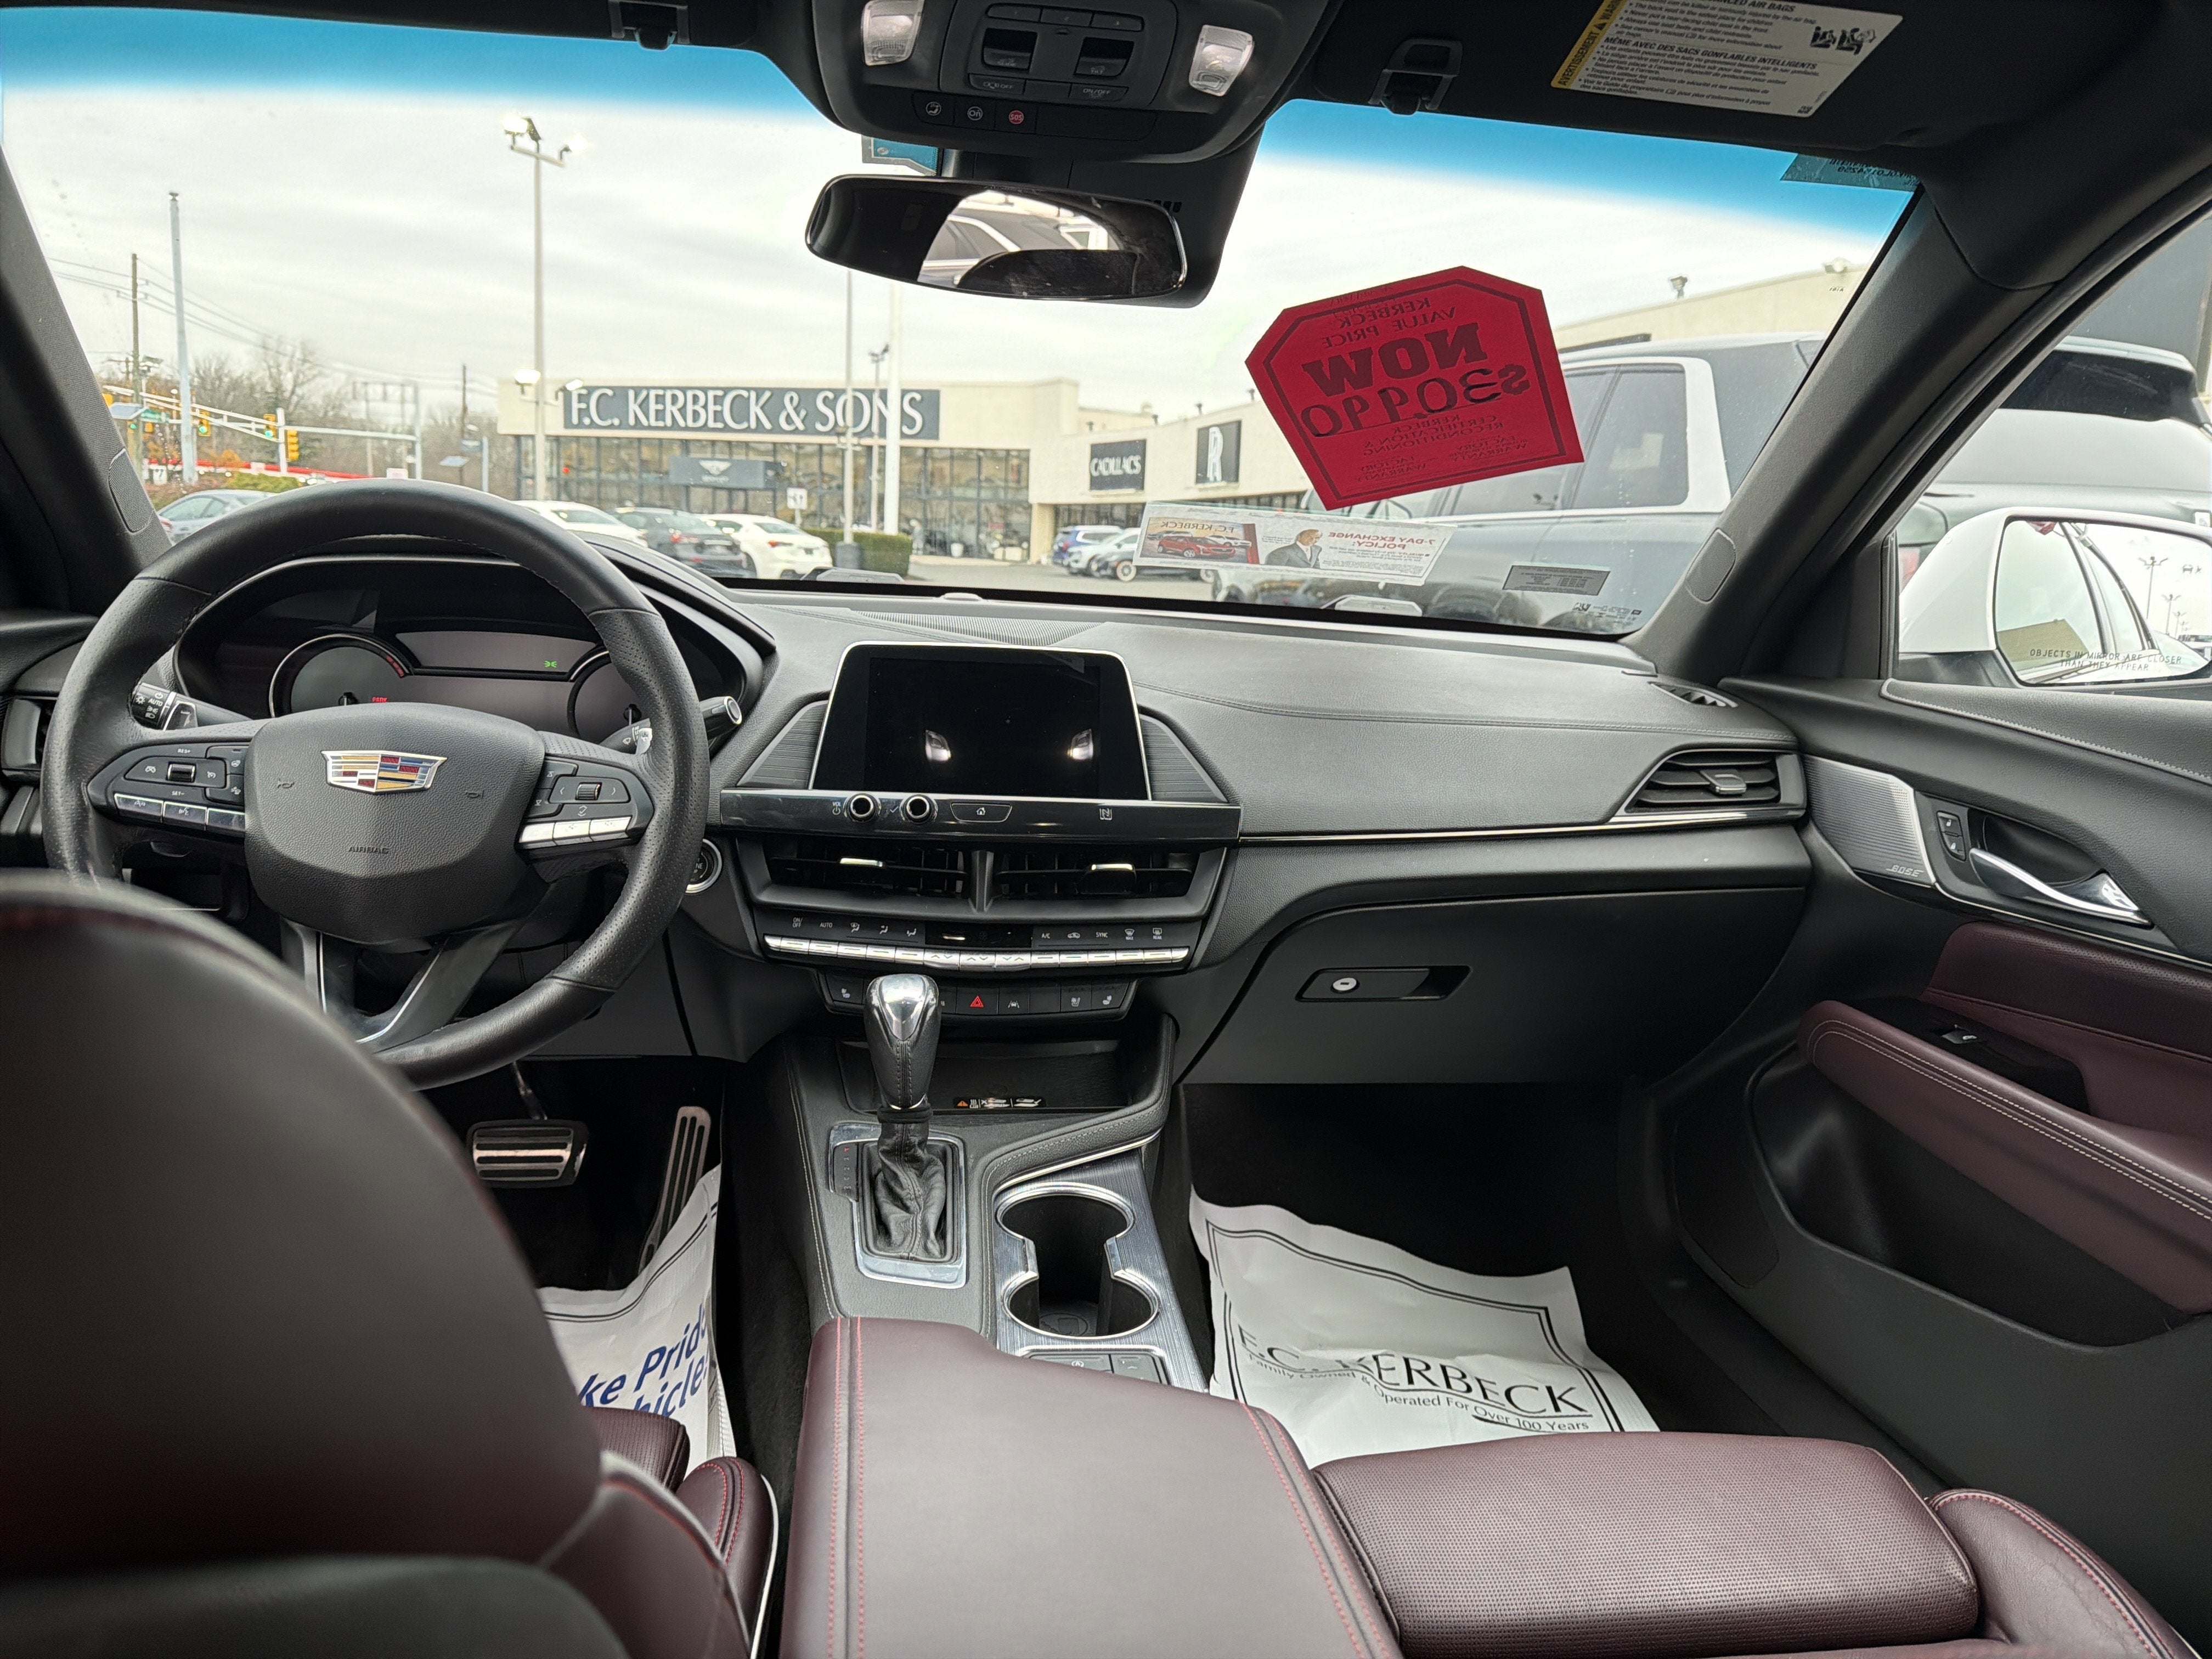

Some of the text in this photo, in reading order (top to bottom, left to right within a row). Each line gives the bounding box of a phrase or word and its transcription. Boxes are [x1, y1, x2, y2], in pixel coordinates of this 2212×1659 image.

[1768, 3, 1796, 12] BAGS
[571, 388, 923, 435] F.C. KERBECK & SONS
[1090, 455, 1142, 477] CADILLACS
[2030, 648, 2071, 658] OBJECTS
[2086, 651, 2120, 661] MIRROR
[2147, 654, 2182, 664] CLOSER
[148, 697, 163, 707] AUTO
[1886, 865, 1924, 877] BOSE
[1335, 1353, 1589, 1414] KERBECK
[1374, 1384, 1441, 1406] Operated
[1446, 1397, 1469, 1412] For
[1474, 1404, 1510, 1424] Over
[1515, 1417, 1543, 1431] 100
[1545, 1420, 1590, 1431] Years
